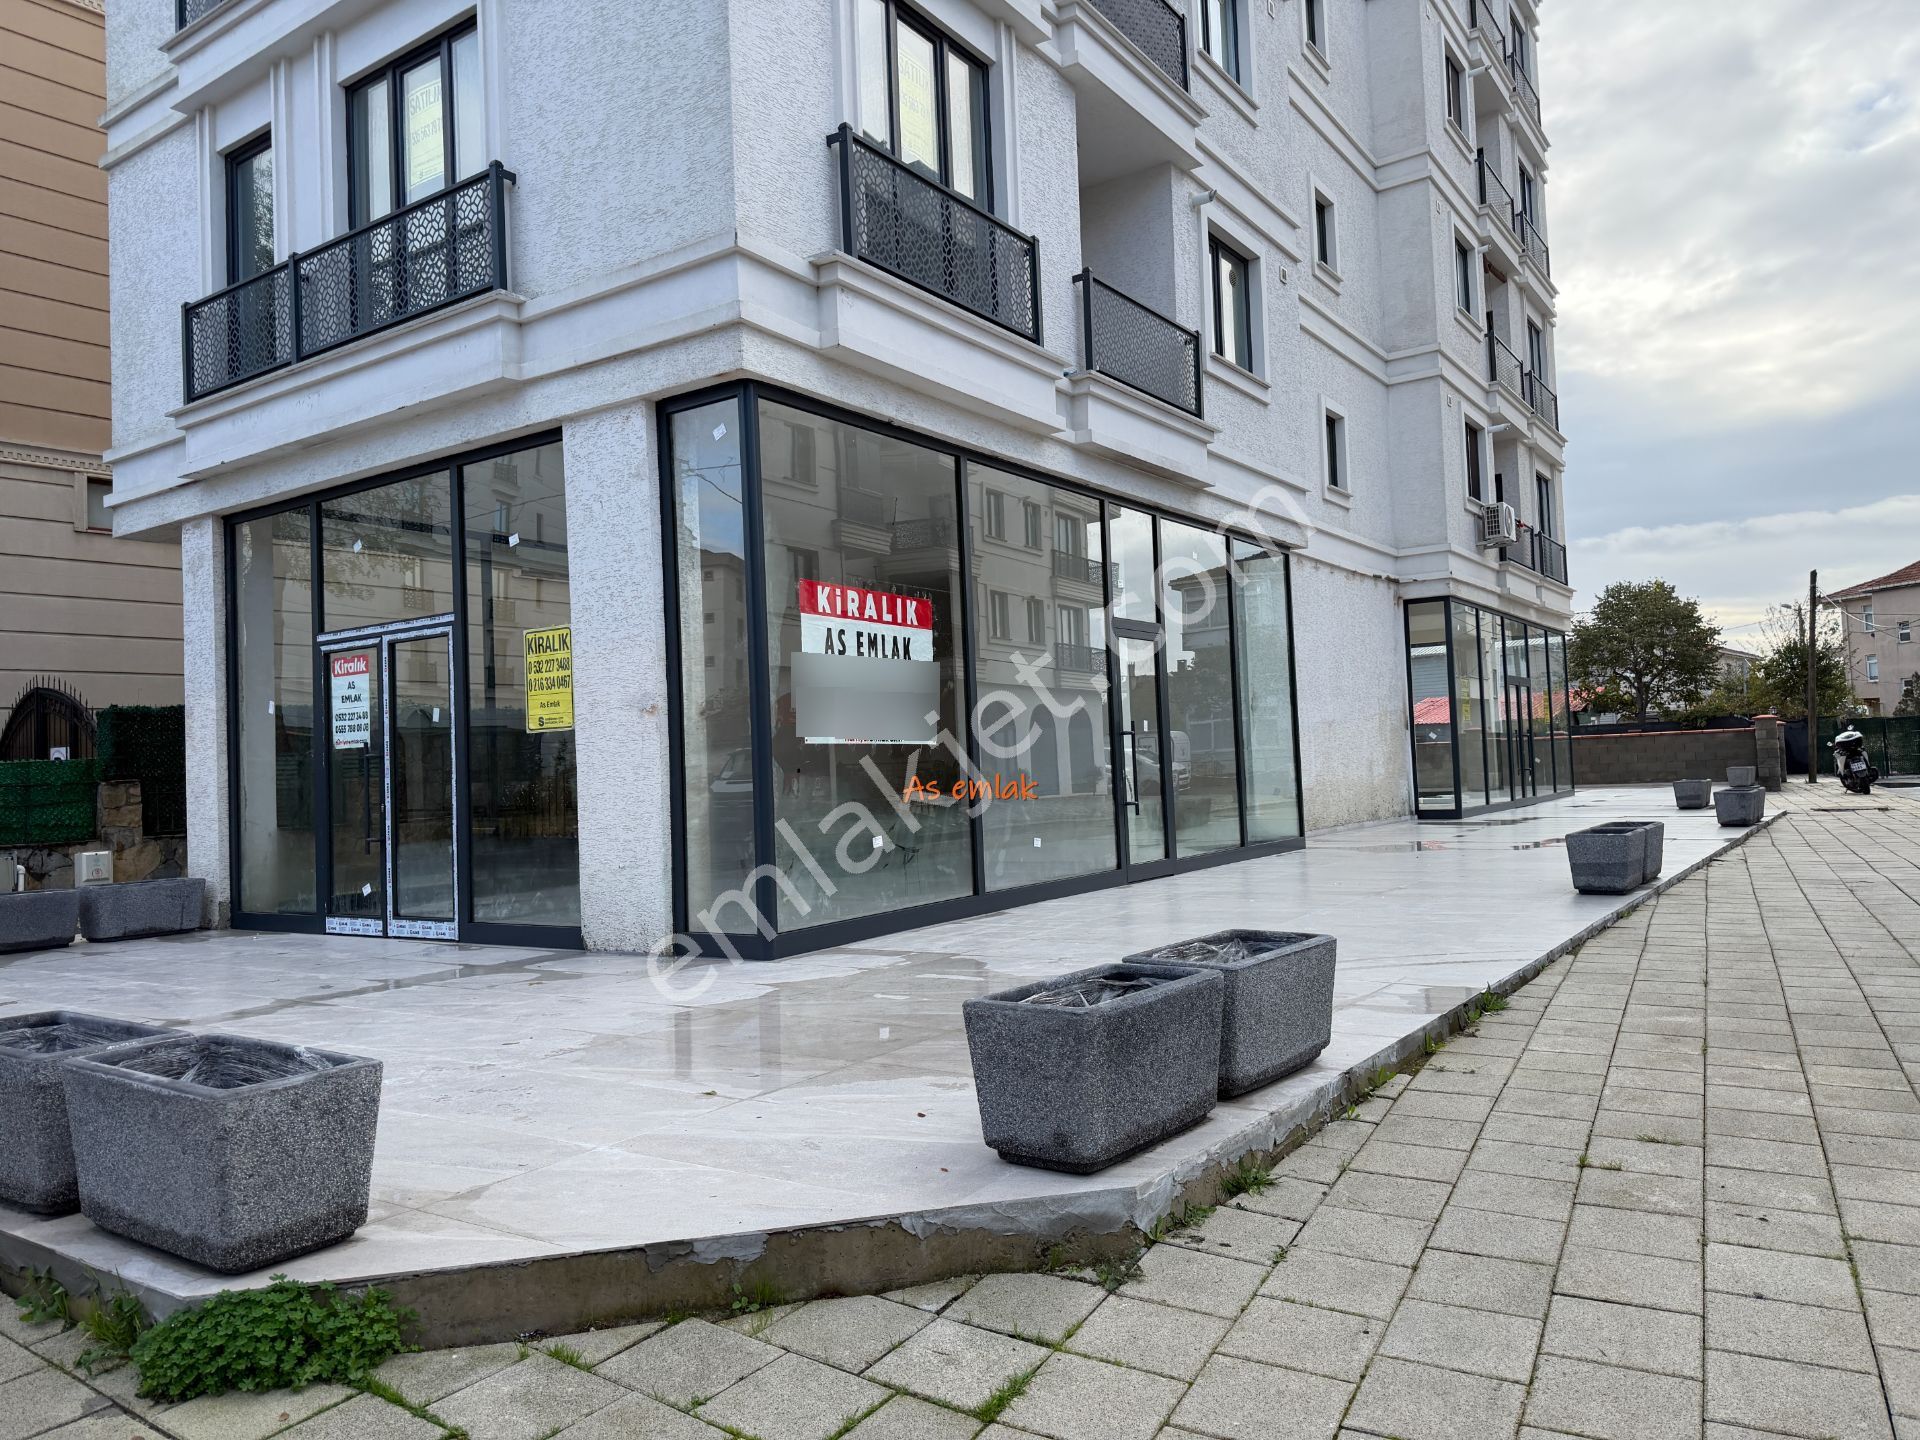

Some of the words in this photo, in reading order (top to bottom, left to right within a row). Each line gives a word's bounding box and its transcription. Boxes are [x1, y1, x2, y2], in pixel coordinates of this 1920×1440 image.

[527, 633, 570, 655] KİRALIK
[824, 628, 846, 655] AS
[856, 631, 912, 660] EMLAK
[334, 657, 367, 675] Kiralık
[528, 661, 533, 675] 0
[545, 659, 555, 673] 227
[347, 681, 356, 689] AS
[529, 679, 533, 692] 0
[533, 677, 544, 691] 216
[545, 676, 556, 690] 334
[341, 694, 363, 703] EMLAK
